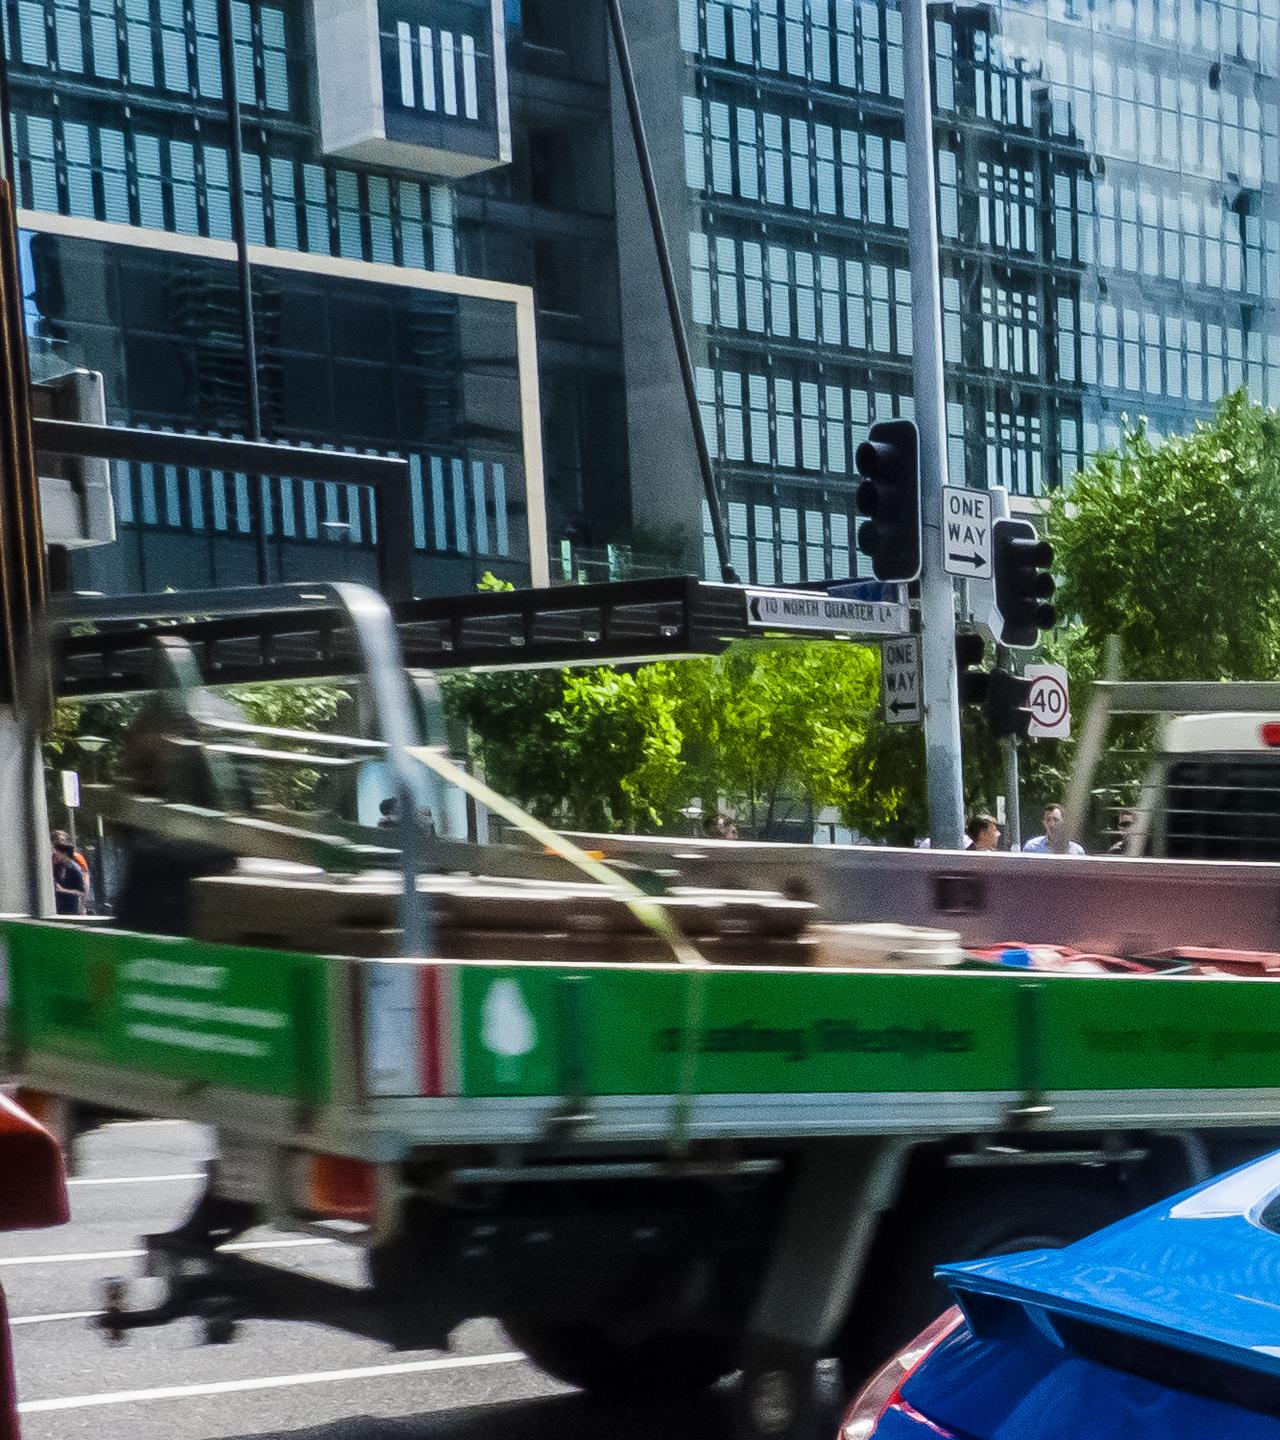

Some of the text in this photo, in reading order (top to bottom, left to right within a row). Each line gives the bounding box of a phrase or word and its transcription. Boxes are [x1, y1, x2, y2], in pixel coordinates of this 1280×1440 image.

[950, 496, 984, 519] ONE
[948, 523, 986, 546] WAY
[765, 600, 779, 613] TO
[783, 601, 819, 617] NORTH
[824, 602, 874, 621] QUARTER
[887, 645, 912, 663] ONE
[886, 672, 916, 691] WAY
[1032, 689, 1062, 713] 40
